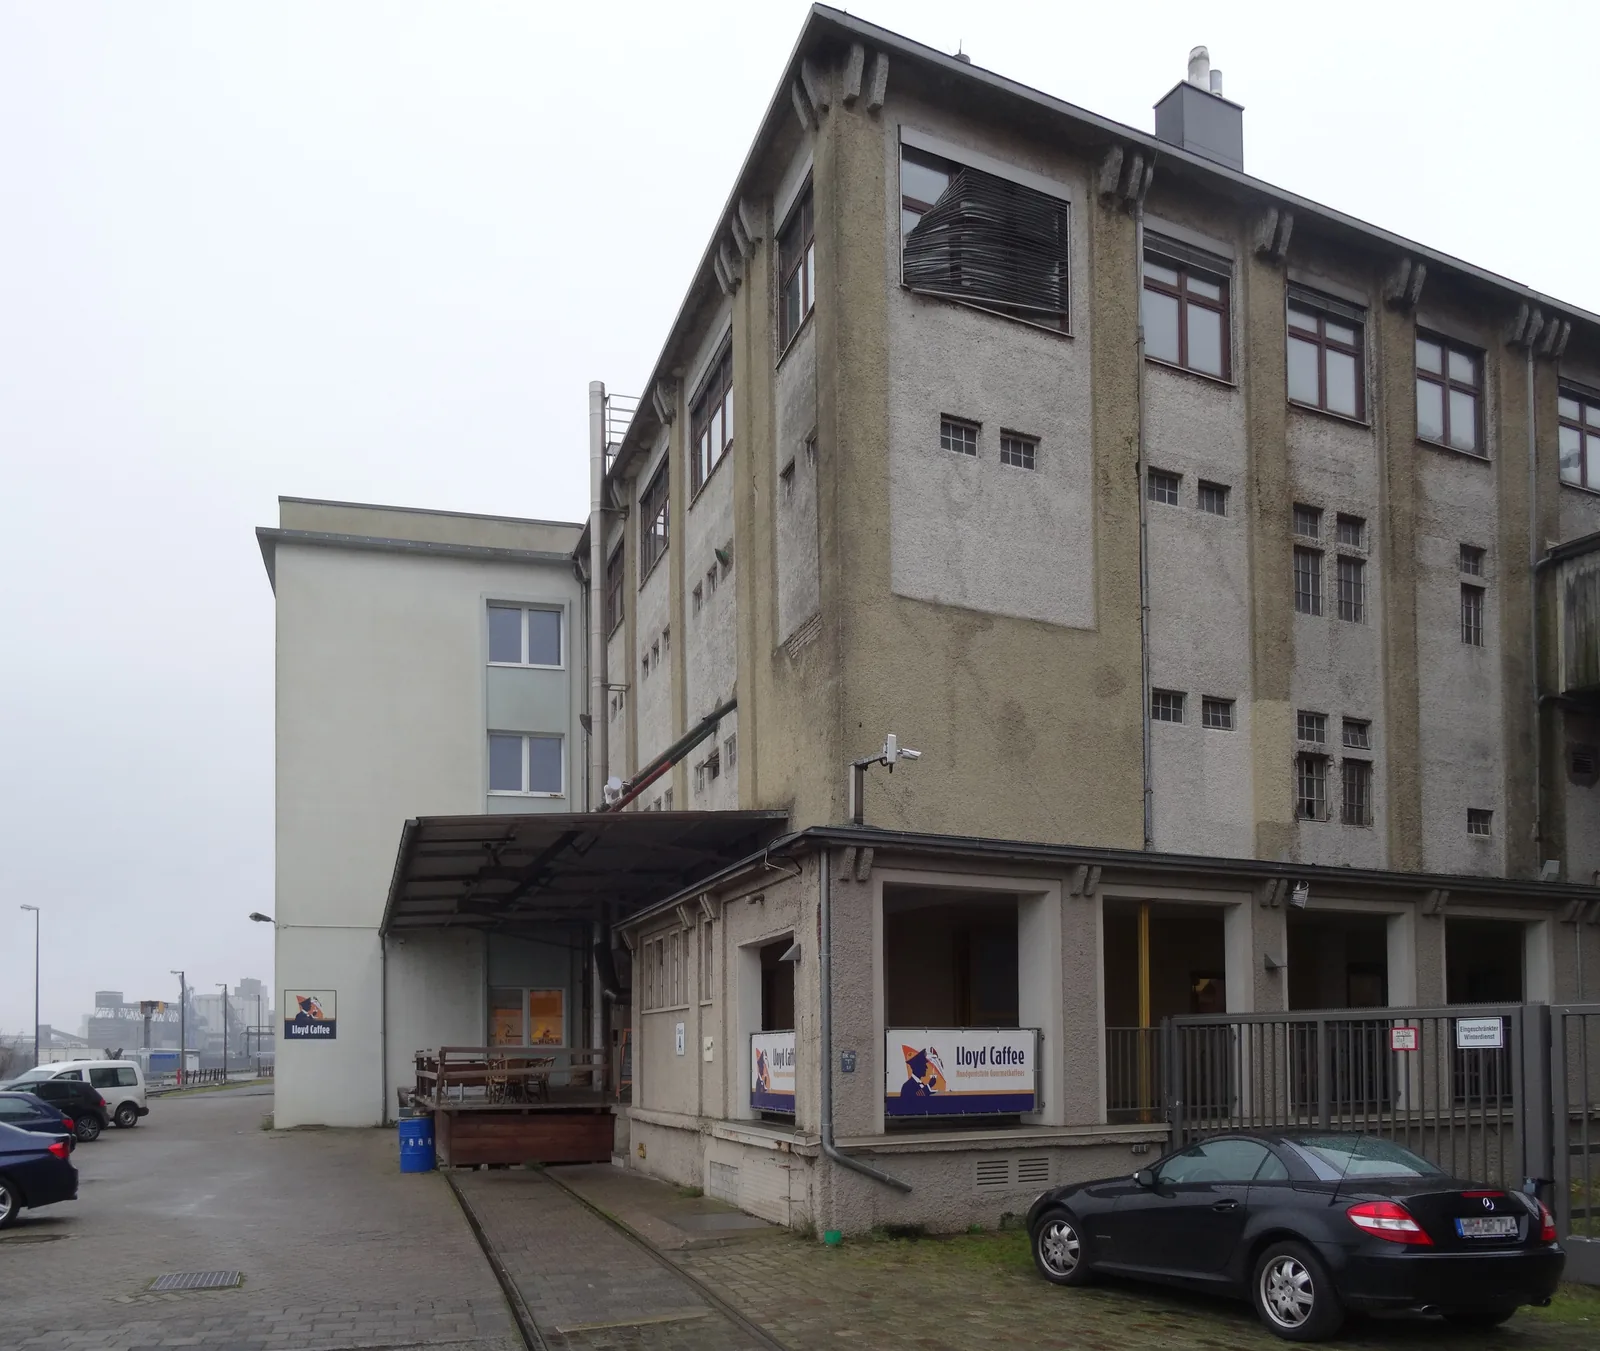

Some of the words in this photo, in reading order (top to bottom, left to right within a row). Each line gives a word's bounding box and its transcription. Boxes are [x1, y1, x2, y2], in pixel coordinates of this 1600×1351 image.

[292, 1025, 309, 1035] Lloyd
[1460, 1025, 1499, 1033] Eingeschränkter
[773, 1048, 785, 1069] Lloyd
[956, 1046, 986, 1068] Lloyd
[990, 1046, 1025, 1065] Caffee
